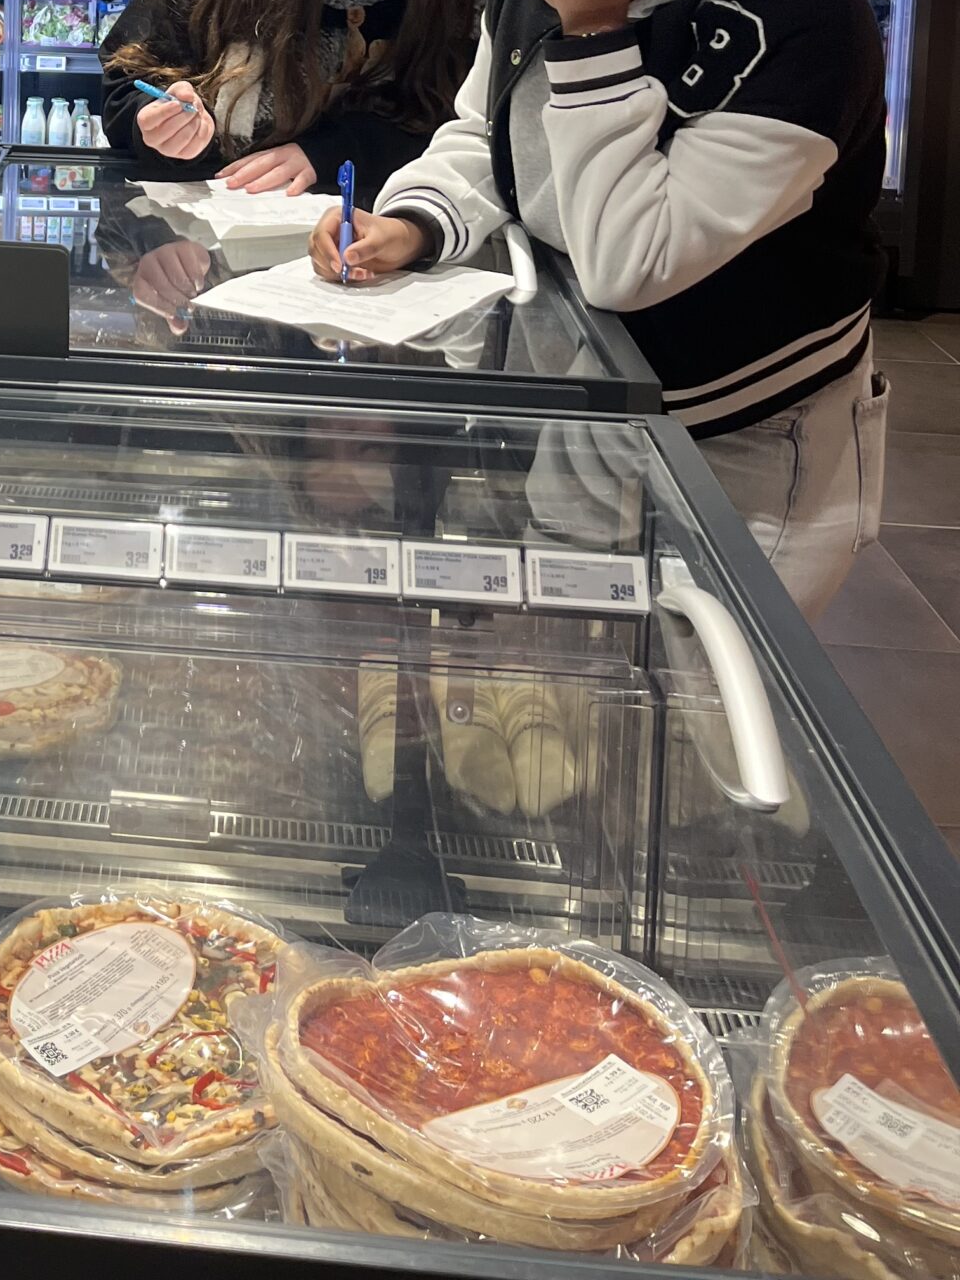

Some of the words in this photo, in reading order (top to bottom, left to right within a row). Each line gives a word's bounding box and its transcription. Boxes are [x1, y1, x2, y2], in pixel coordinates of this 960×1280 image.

[10, 544, 33, 560] 3.29
[125, 551, 149, 568] 3.29
[243, 558, 266, 576] 3.49
[365, 567, 387, 584] 1.99
[483, 575, 508, 592] 3.49
[610, 583, 635, 601] 3.49
[34, 942, 73, 969] PIZZA
